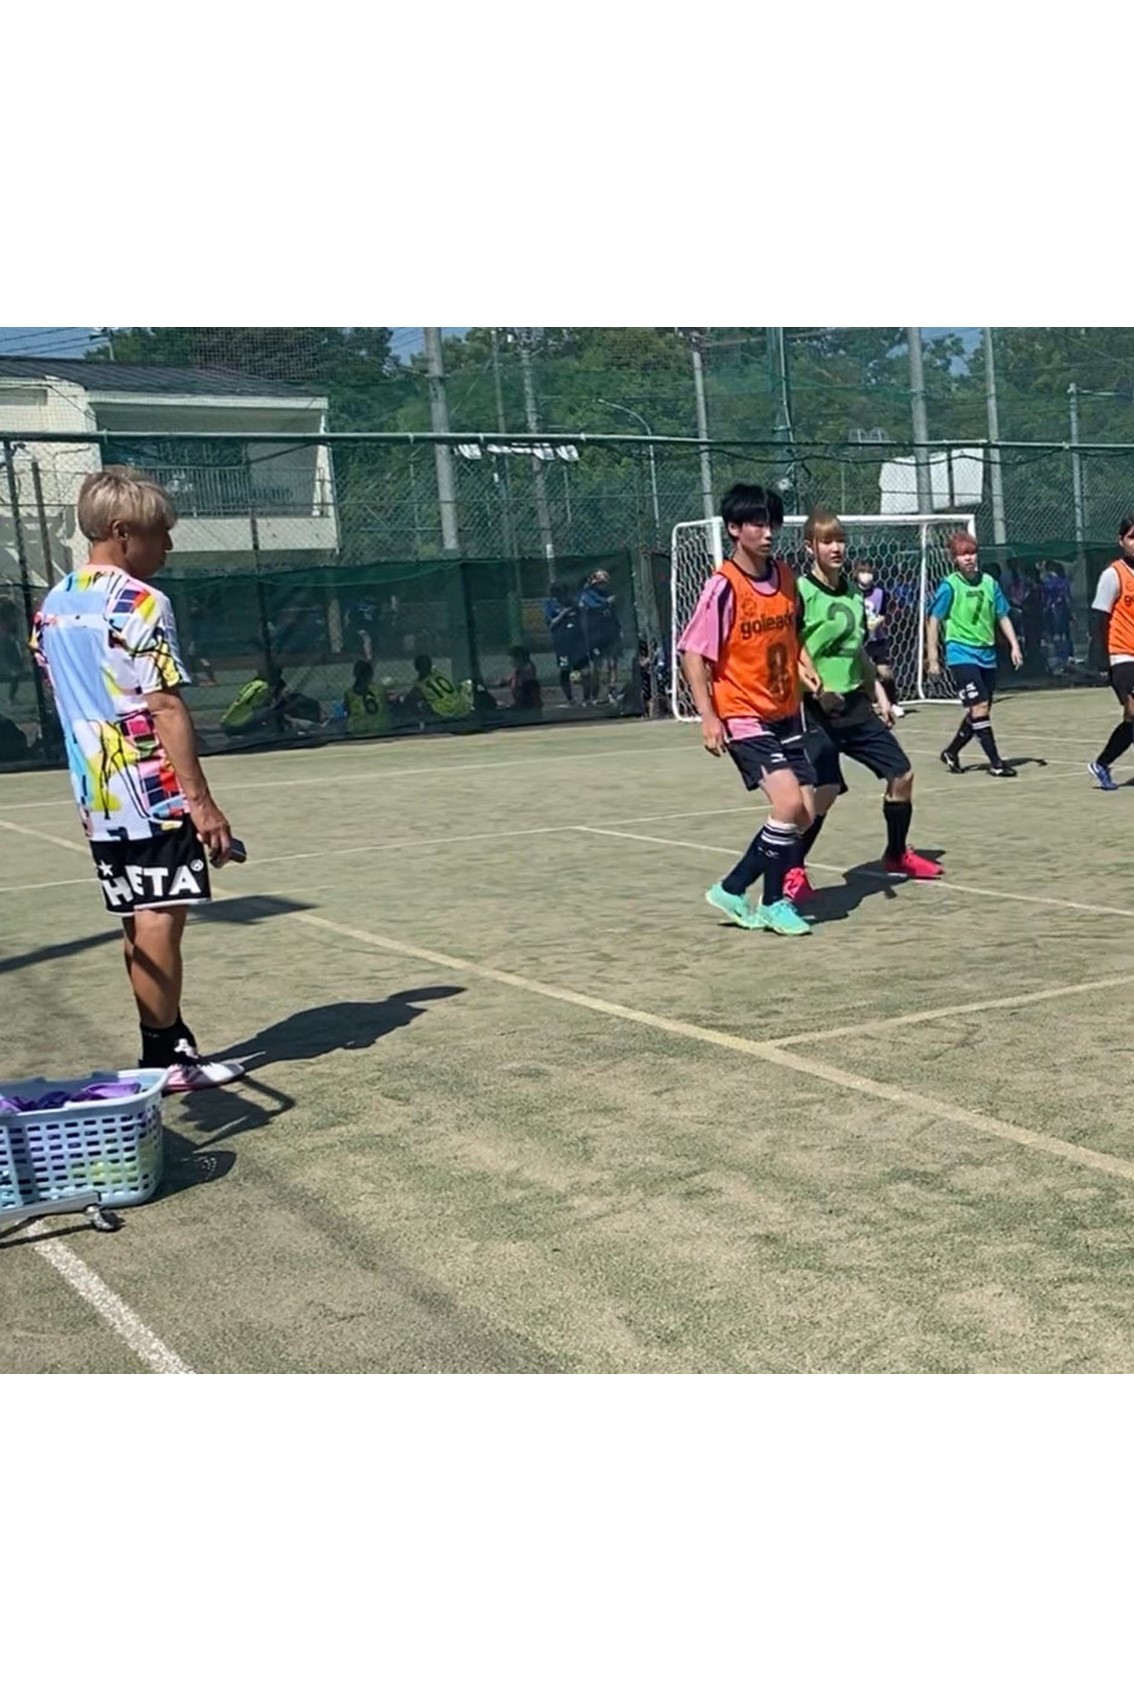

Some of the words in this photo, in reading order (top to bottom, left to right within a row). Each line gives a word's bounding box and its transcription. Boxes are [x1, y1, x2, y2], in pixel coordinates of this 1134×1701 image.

[966, 590, 985, 626] 7
[813, 602, 858, 658] 2
[426, 675, 456, 699] 10
[361, 690, 380, 716] 6
